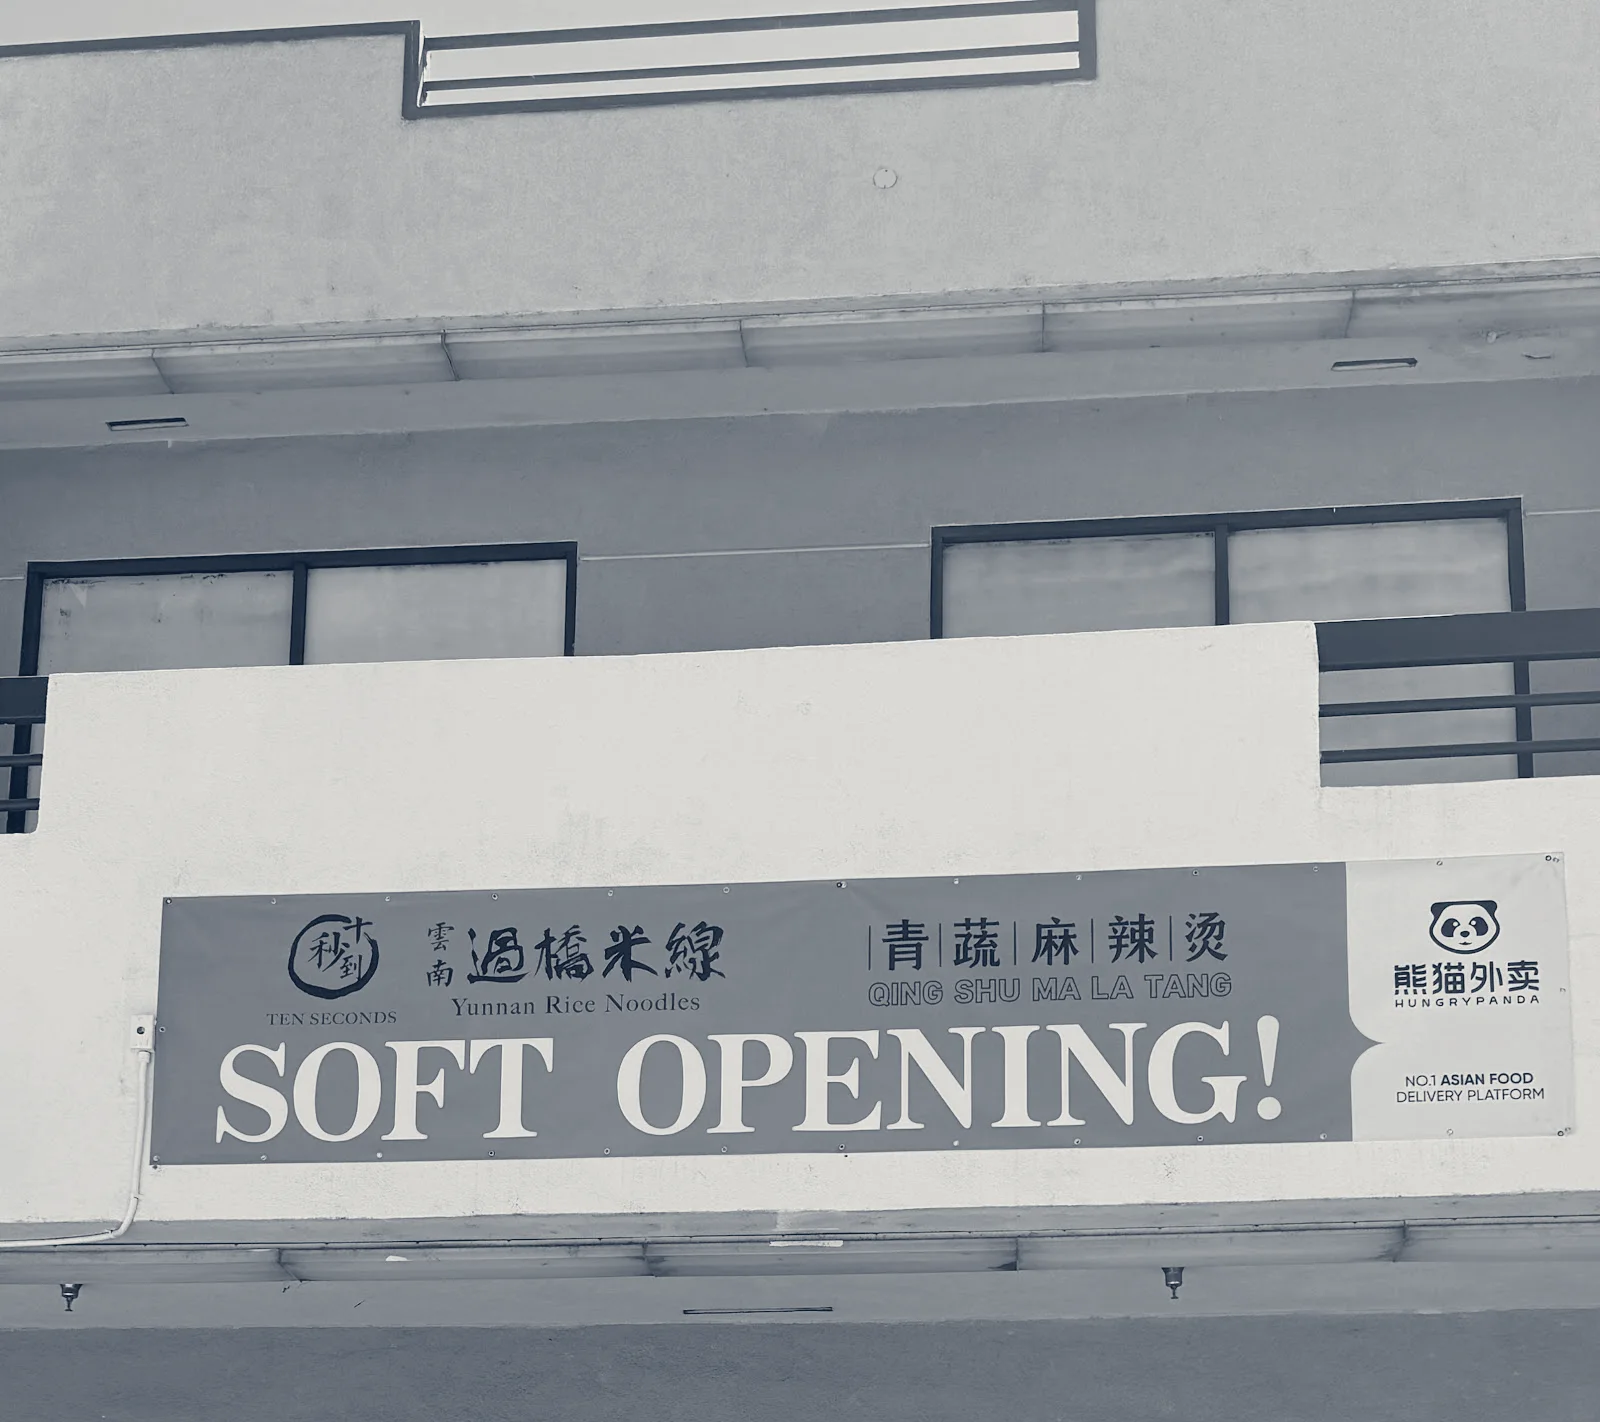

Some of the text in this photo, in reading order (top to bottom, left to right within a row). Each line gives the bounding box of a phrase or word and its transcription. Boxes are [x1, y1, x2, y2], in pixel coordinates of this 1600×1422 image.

[427, 921, 454, 987] 雲南
[466, 921, 726, 984] 過橋米線
[868, 972, 1232, 1007] QING SHU MA LA TANG
[1394, 960, 1540, 996] 熊猫外卖
[451, 992, 700, 1017] Yunnan Rice Noodles
[1395, 994, 1540, 1008] HUNGRYPANDA
[266, 1010, 397, 1026] TEN SECONDS
[215, 1014, 1283, 1144] SOFT OPENING!
[1405, 1072, 1534, 1087] NO.1 ASIAN FOOD
[1396, 1087, 1545, 1103] DELIVERY PLATFORM
